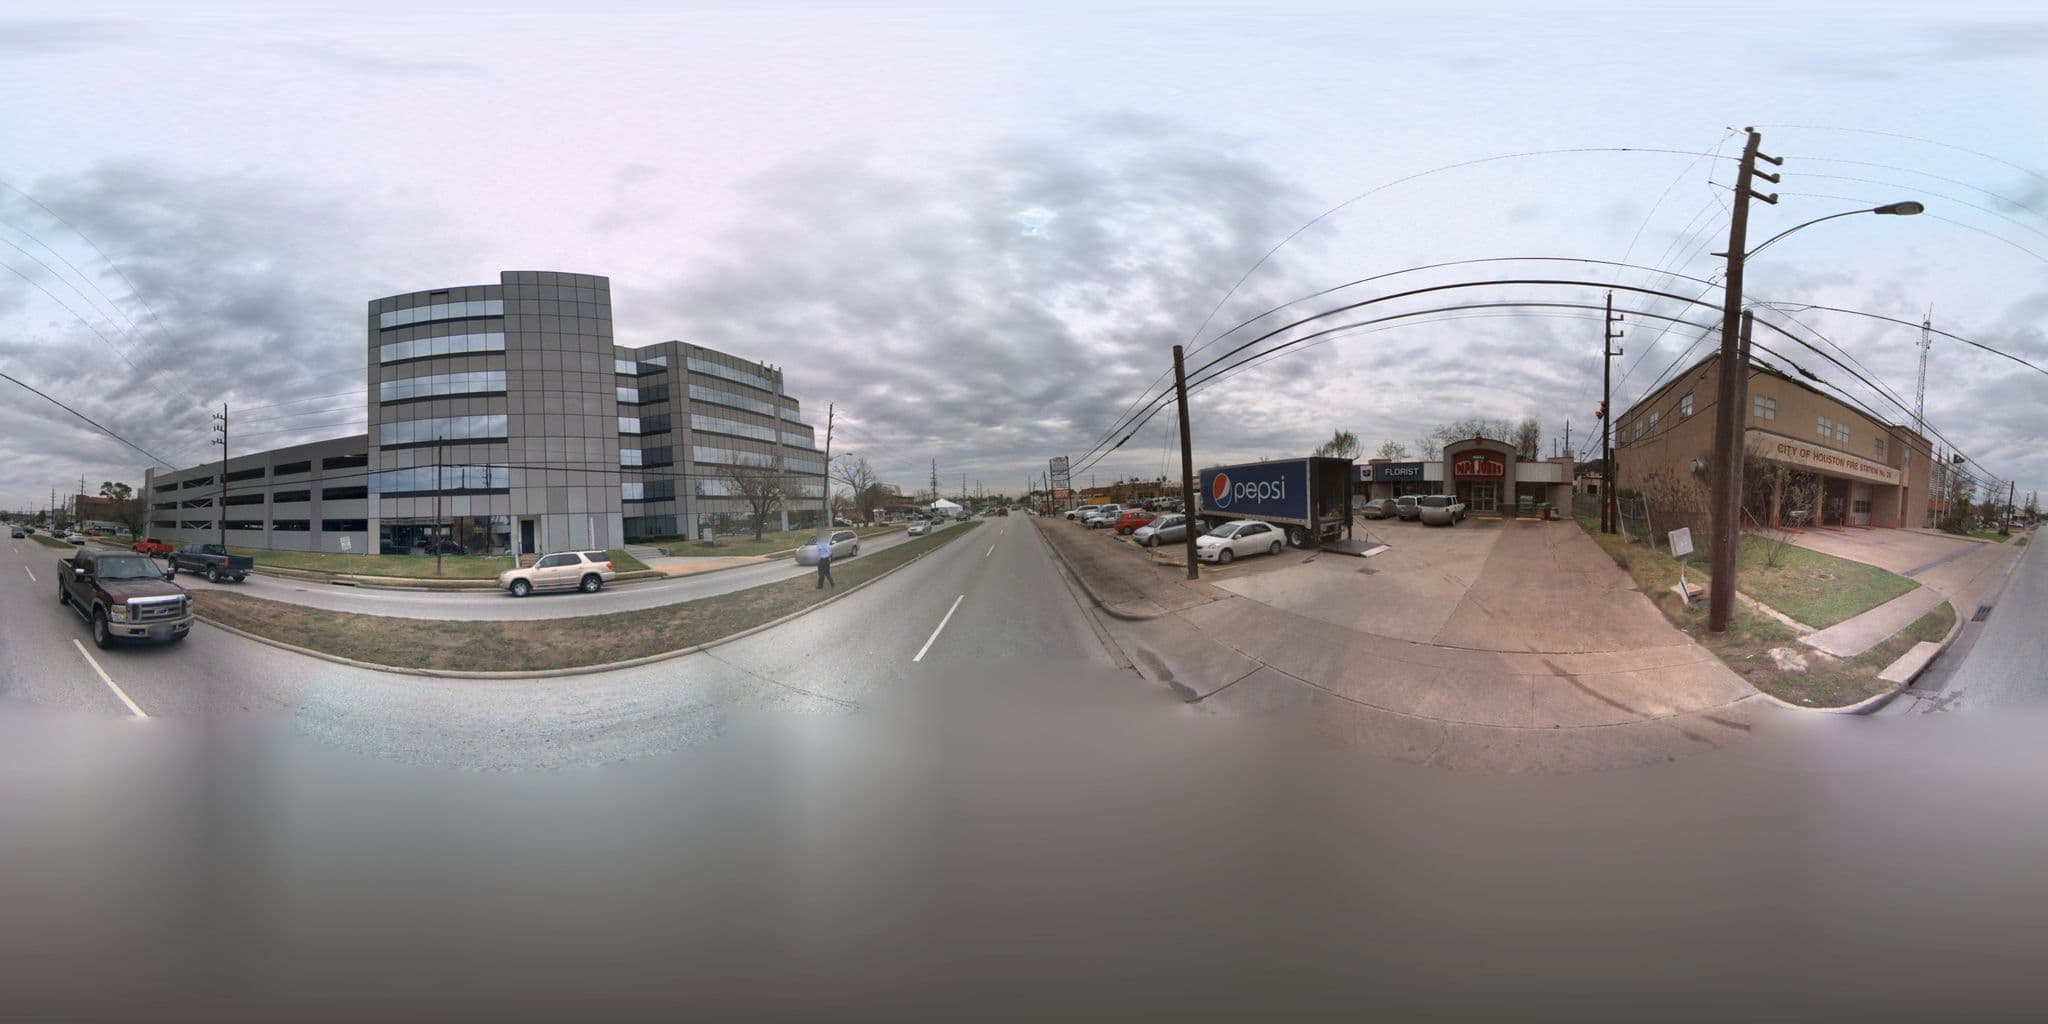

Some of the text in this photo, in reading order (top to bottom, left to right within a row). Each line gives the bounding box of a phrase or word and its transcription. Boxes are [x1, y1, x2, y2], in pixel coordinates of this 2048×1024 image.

[1384, 467, 1419, 477] FLORIST
[1777, 443, 1798, 456] CITY
[1800, 448, 1810, 459] OF
[1813, 452, 1844, 467] HOUSTON
[1846, 460, 1859, 471] FIRE
[1859, 464, 1878, 475] STATION
[1234, 475, 1285, 504] pepsi
